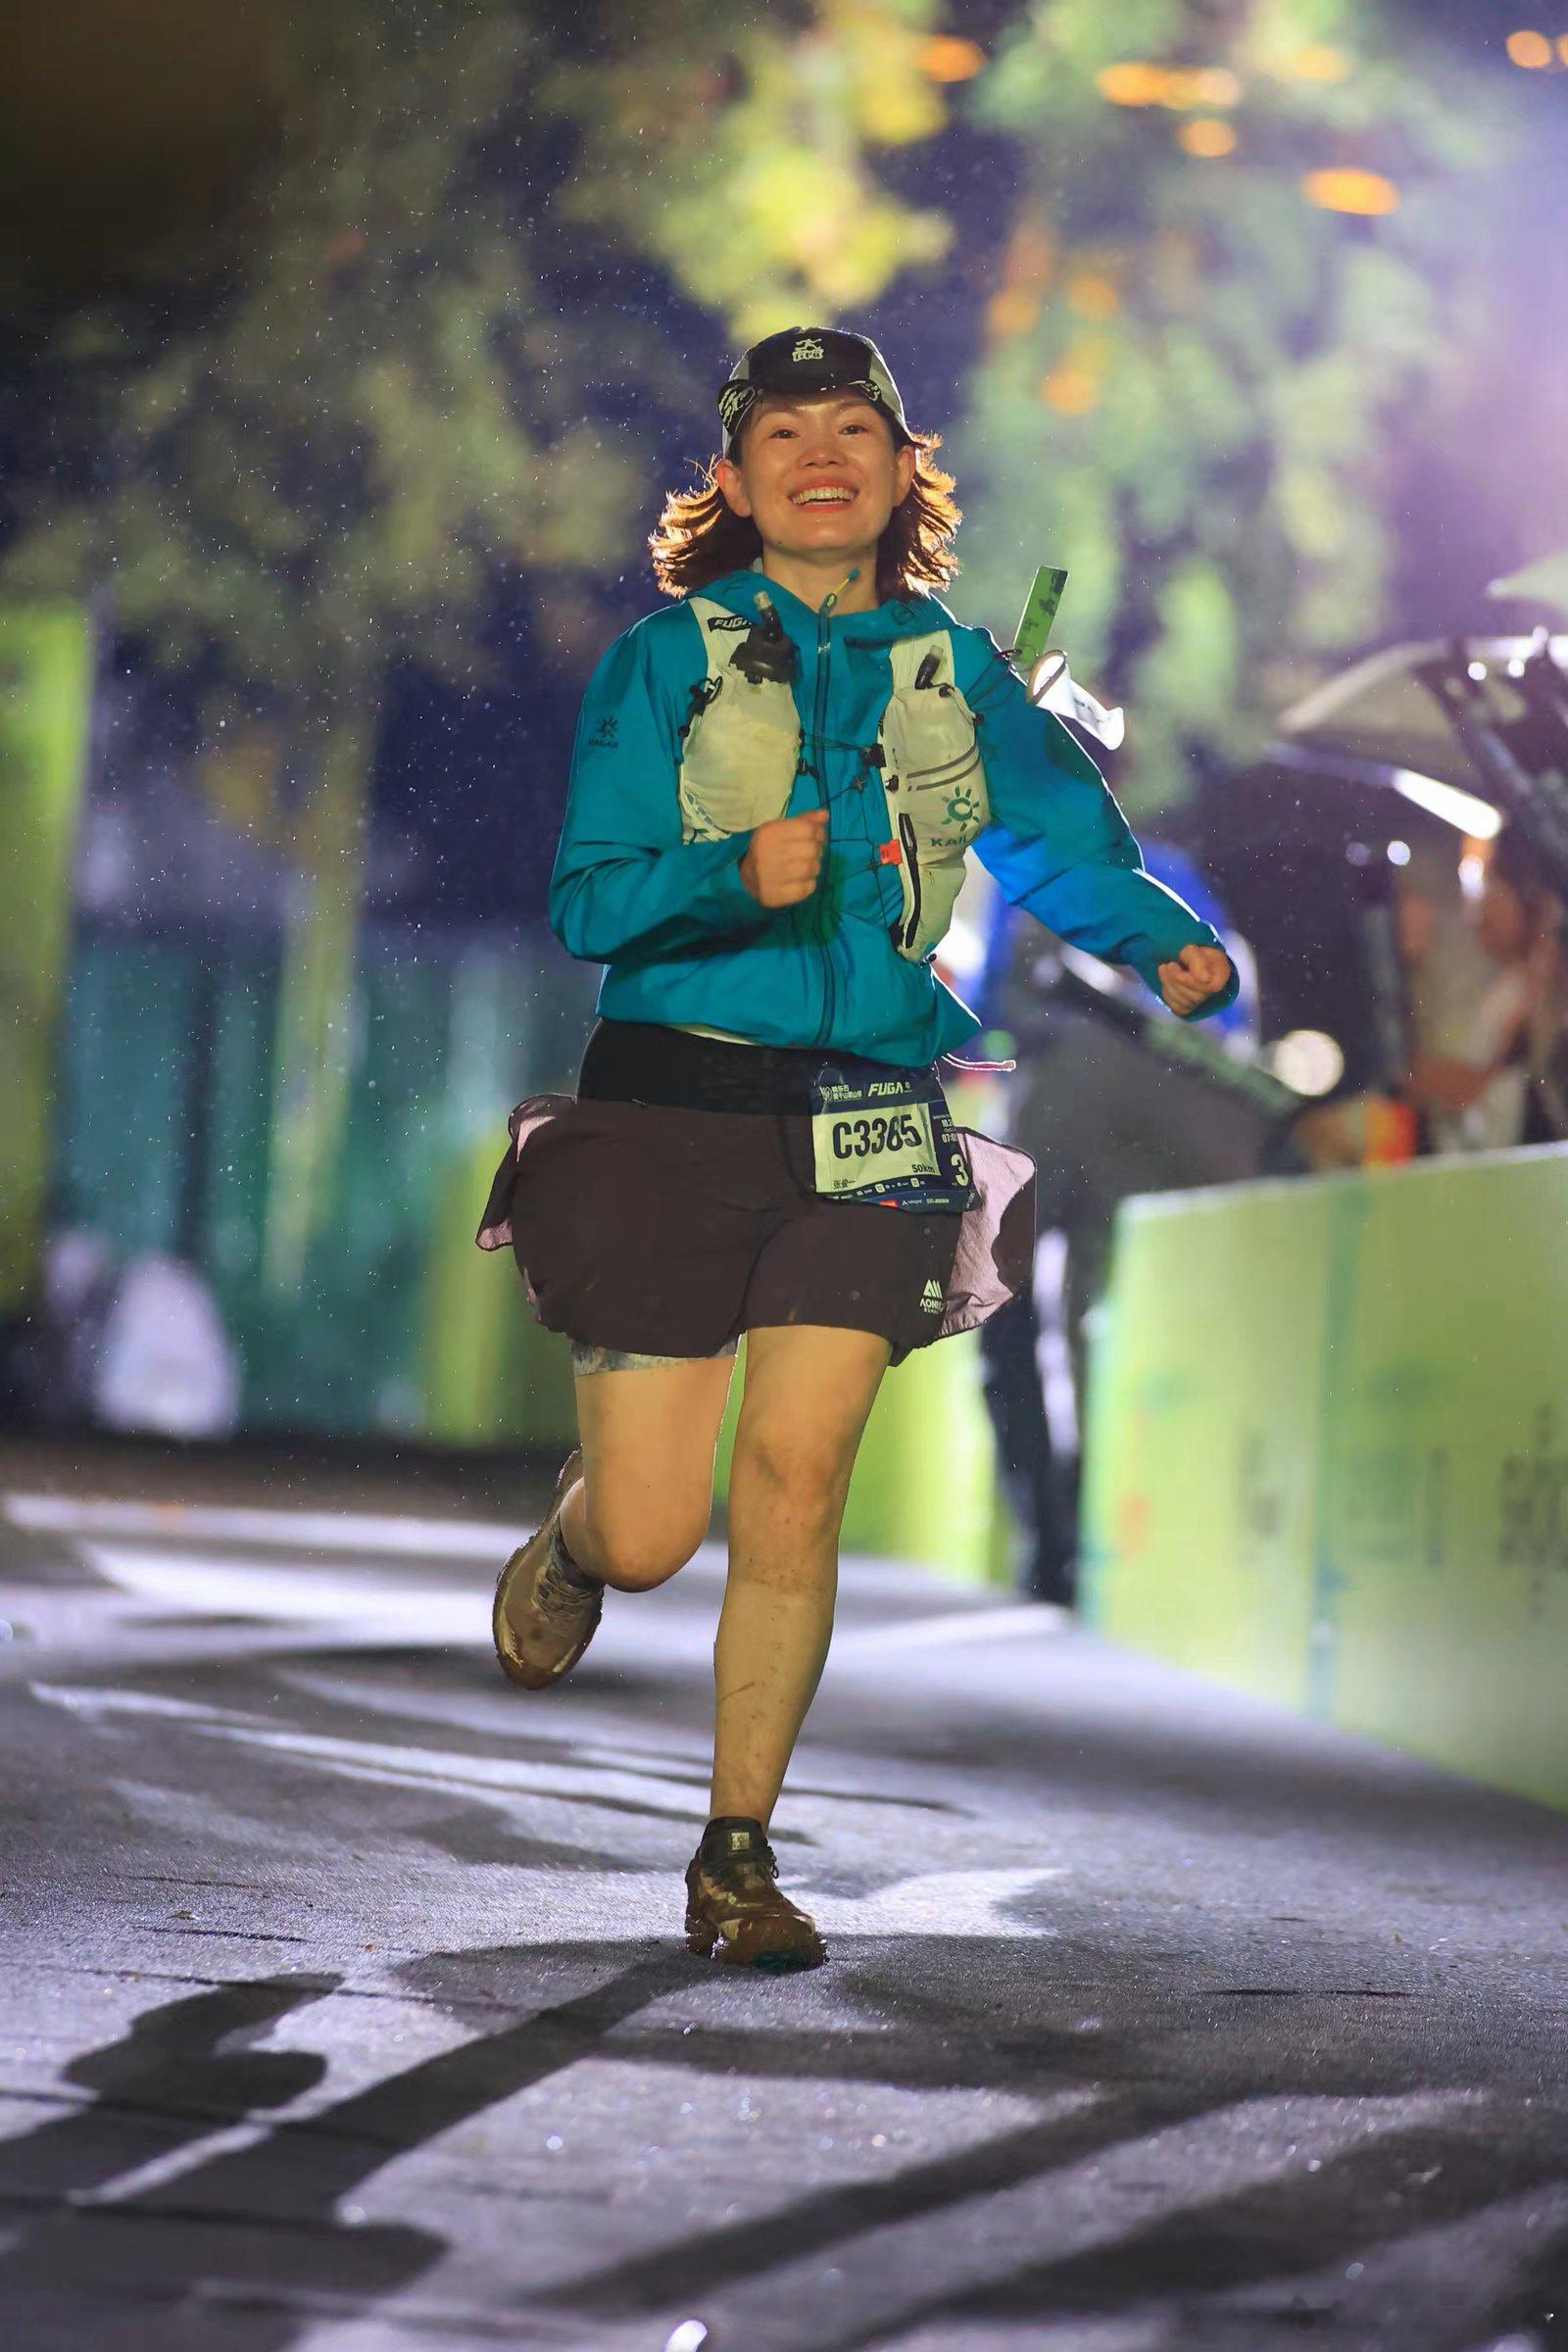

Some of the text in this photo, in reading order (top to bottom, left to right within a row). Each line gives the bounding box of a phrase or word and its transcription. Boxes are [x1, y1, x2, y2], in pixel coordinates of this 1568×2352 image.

[867, 1082, 904, 1097] FUGA
[833, 1114, 922, 1159] C3365
[911, 1163, 936, 1174] 50km
